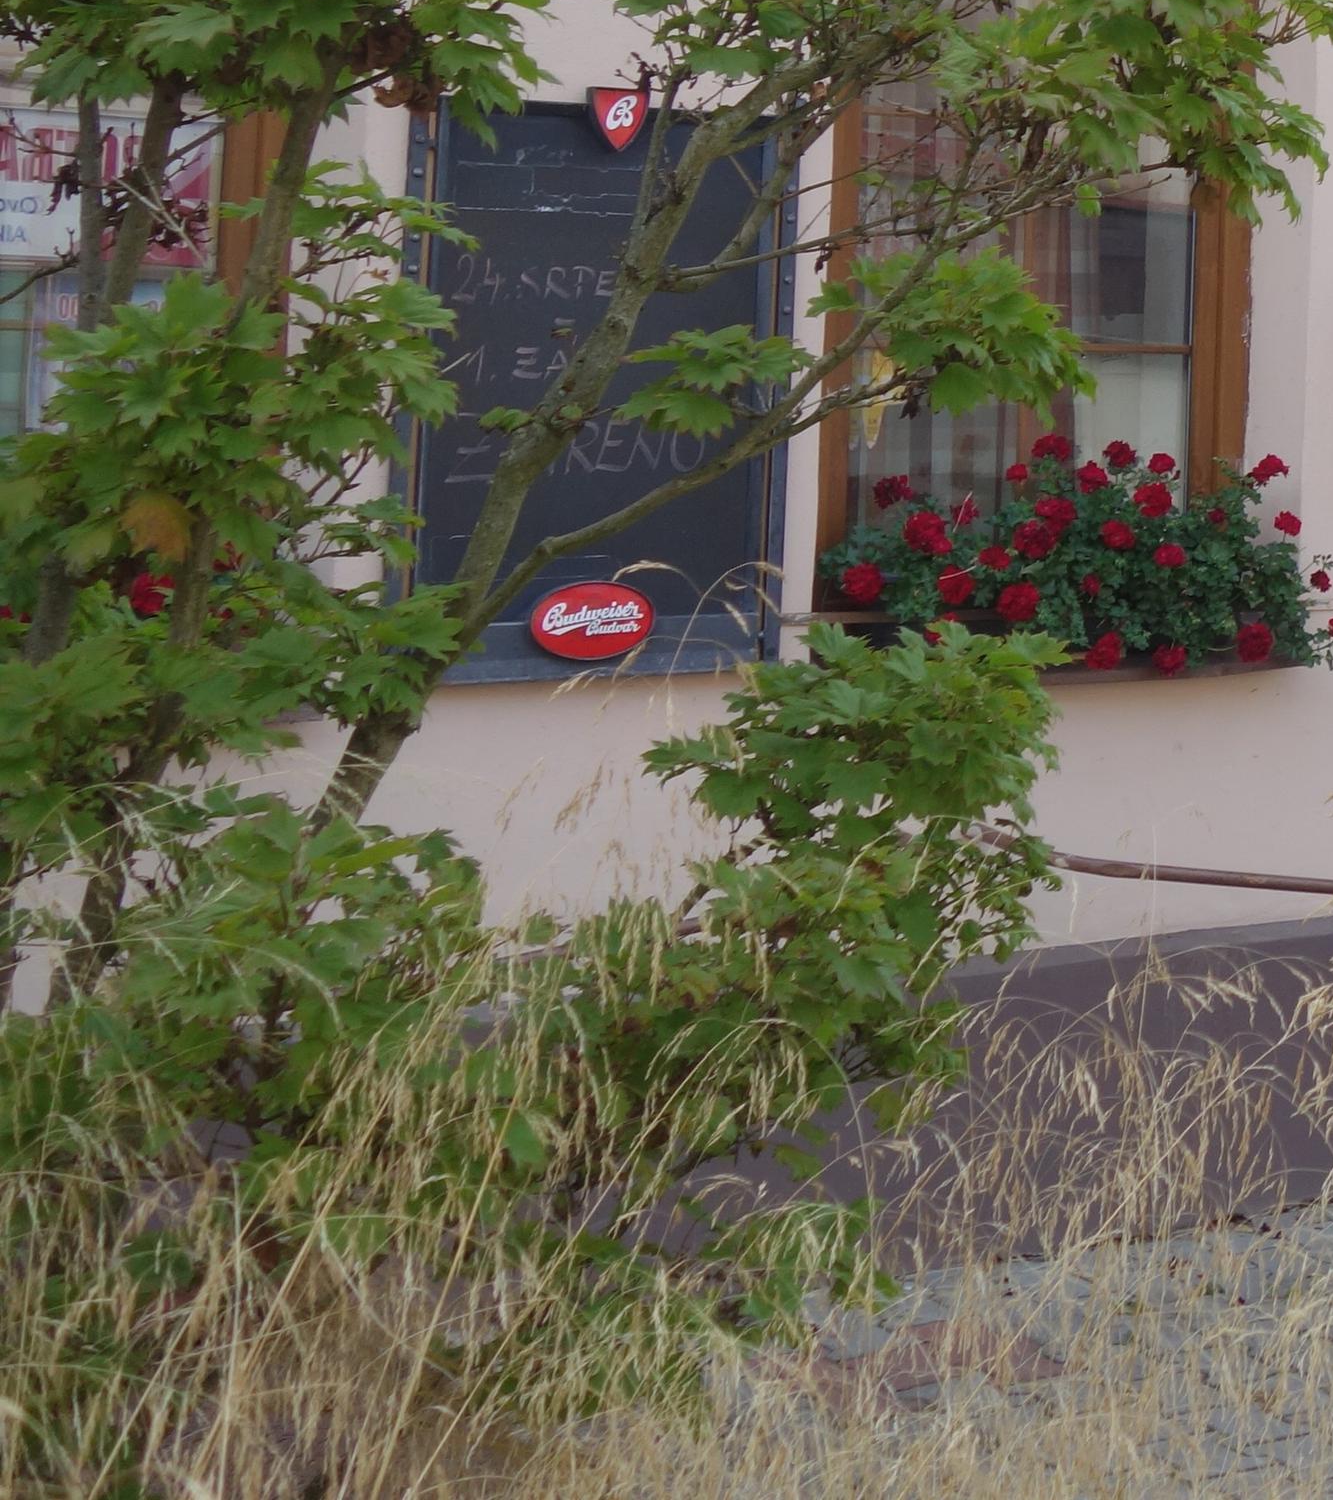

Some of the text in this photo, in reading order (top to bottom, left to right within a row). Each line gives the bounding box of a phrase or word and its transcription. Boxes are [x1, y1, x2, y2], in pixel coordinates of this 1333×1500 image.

[519, 265, 618, 301] SRPE
[542, 601, 644, 635] Budweiser
[585, 619, 641, 636] Budvar
